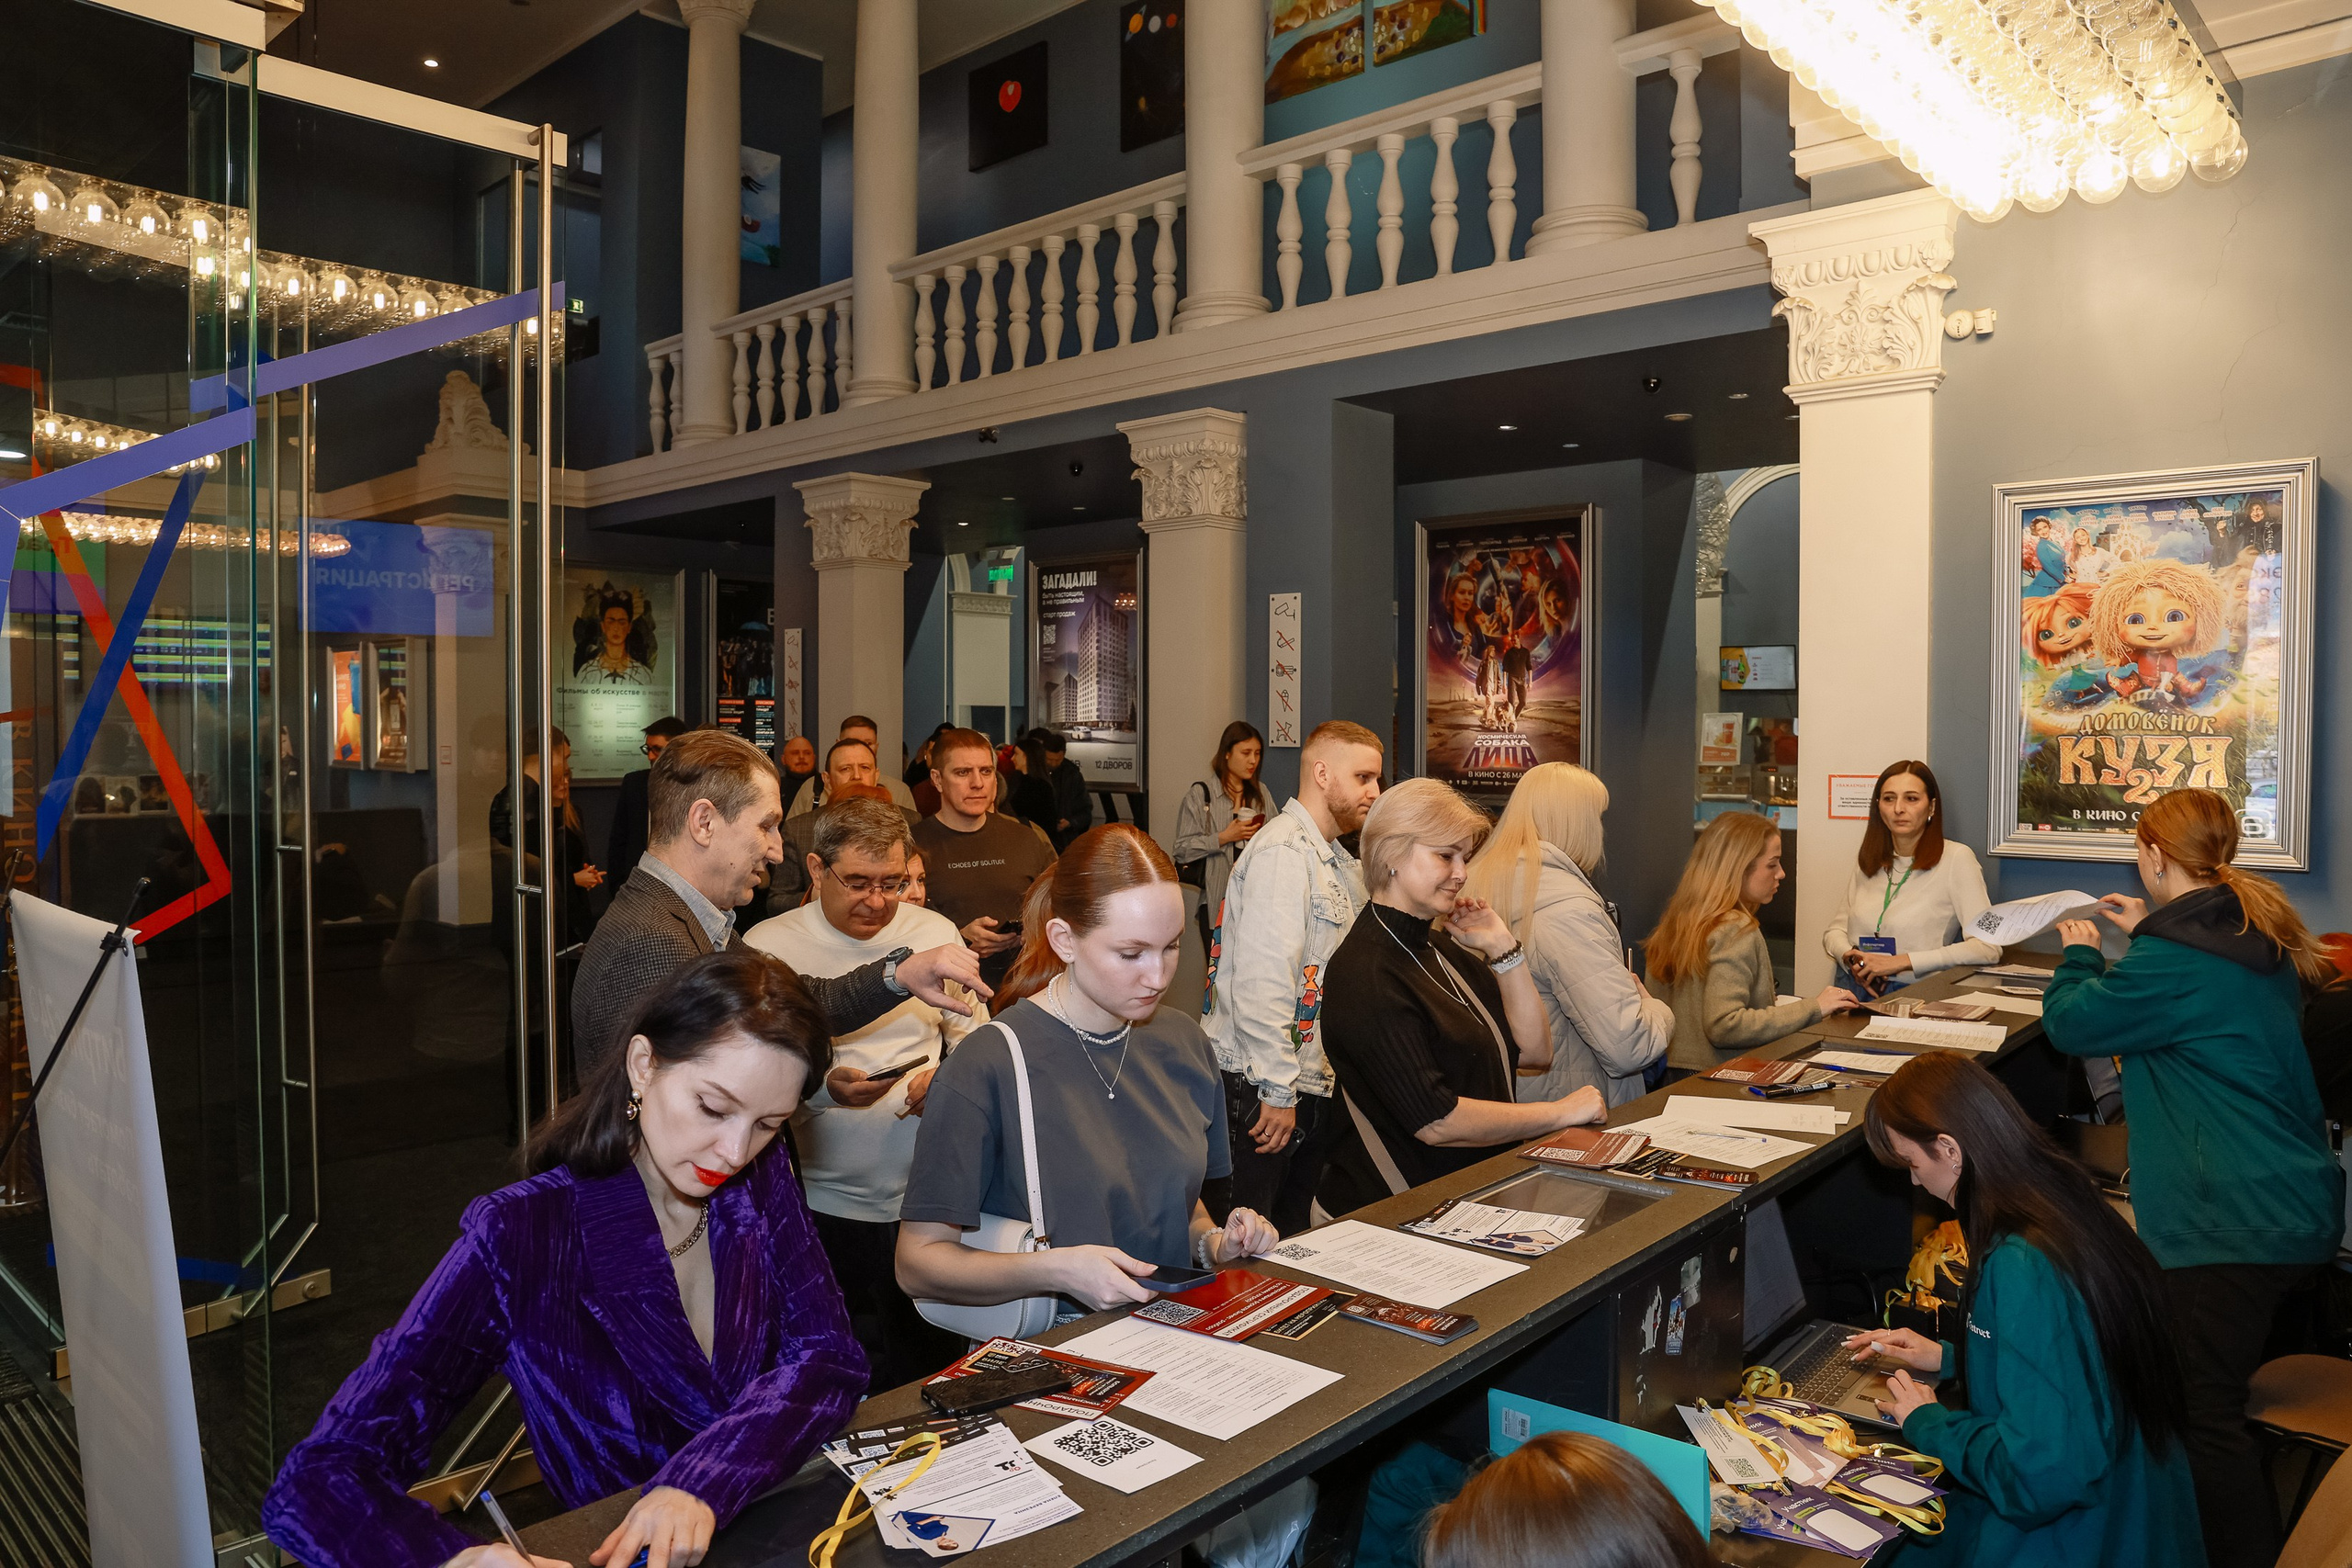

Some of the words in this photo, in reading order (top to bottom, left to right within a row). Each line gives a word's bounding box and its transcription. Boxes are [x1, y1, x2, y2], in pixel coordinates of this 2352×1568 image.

[1042, 570, 1097, 589] ЗАГАДАЛИ!
[1054, 597, 1084, 605] правильным
[556, 687, 589, 695] Фильмы
[2079, 709, 2216, 734] ДОМОВЁНОК
[1095, 761, 1102, 769] 12
[1102, 761, 1133, 770] ДВОРОВ
[1462, 746, 1540, 768] ЛИДА
[2057, 735, 2233, 788] КУЗЯ
[2122, 768, 2159, 804] 2
[2073, 809, 2081, 819] В
[2086, 809, 2127, 821] КИНО
[1024, 1398, 1095, 1417] ПОДАРОЧН
[1781, 1496, 1815, 1513] Участник
